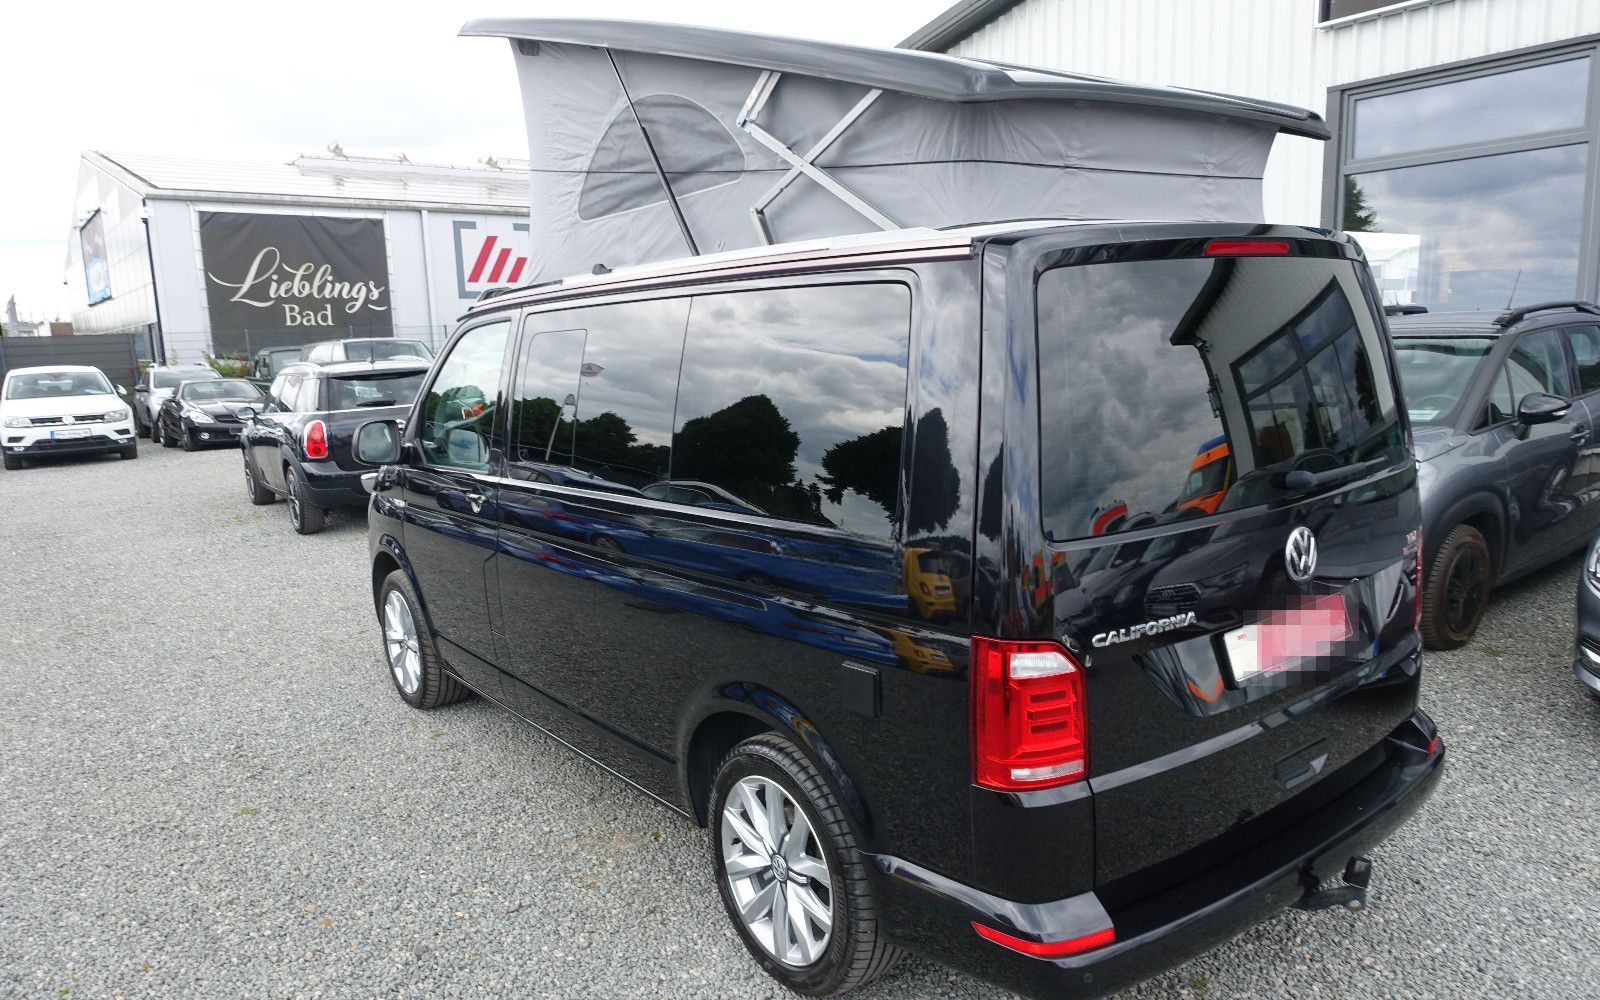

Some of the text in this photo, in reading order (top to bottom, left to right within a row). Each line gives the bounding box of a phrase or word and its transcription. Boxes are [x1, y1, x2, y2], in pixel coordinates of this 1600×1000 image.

[208, 246, 388, 313] Lieblings
[282, 304, 335, 326] Bad
[1091, 611, 1198, 648] CALIFORNIA
